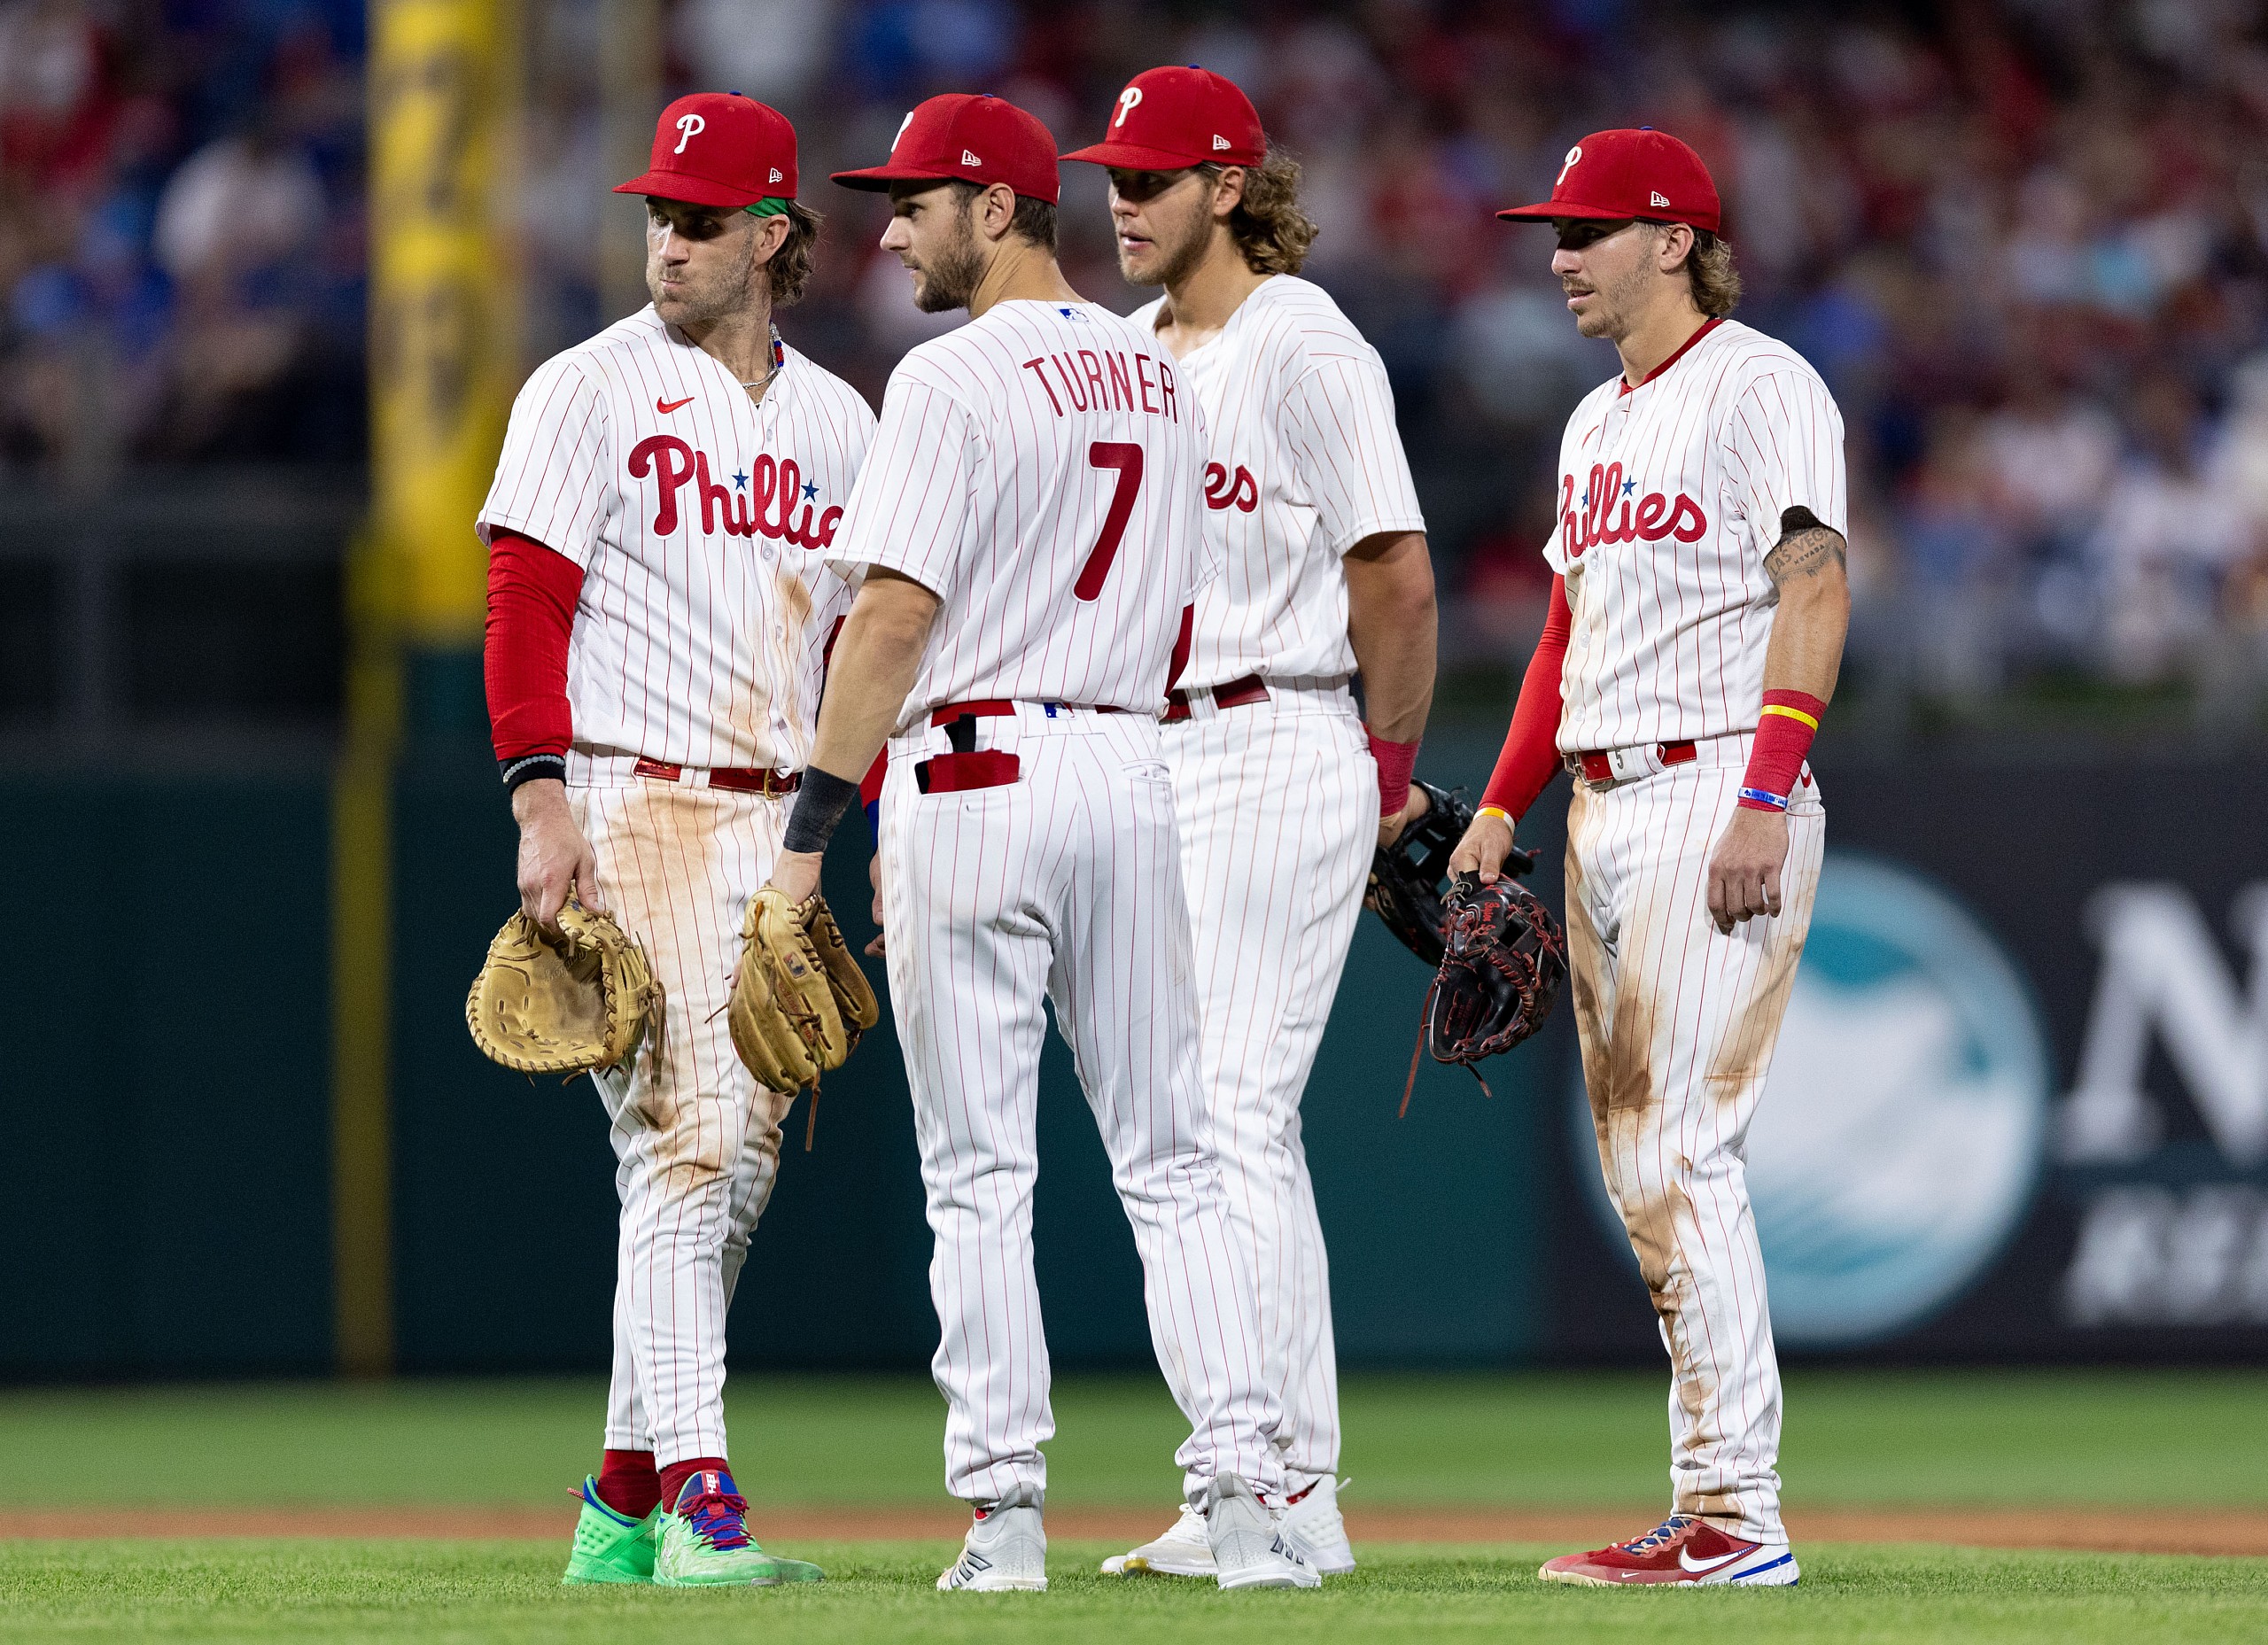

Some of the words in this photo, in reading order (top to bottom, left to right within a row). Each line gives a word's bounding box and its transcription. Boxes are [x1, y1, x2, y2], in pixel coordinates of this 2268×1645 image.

[673, 113, 705, 154] P
[1115, 87, 1143, 128] P
[1022, 350, 1178, 424] TURNER
[628, 435, 844, 550] Phillie
[1074, 441, 1144, 601] 7
[1560, 462, 1707, 563] hillies
[1792, 528, 1828, 552] VEG
